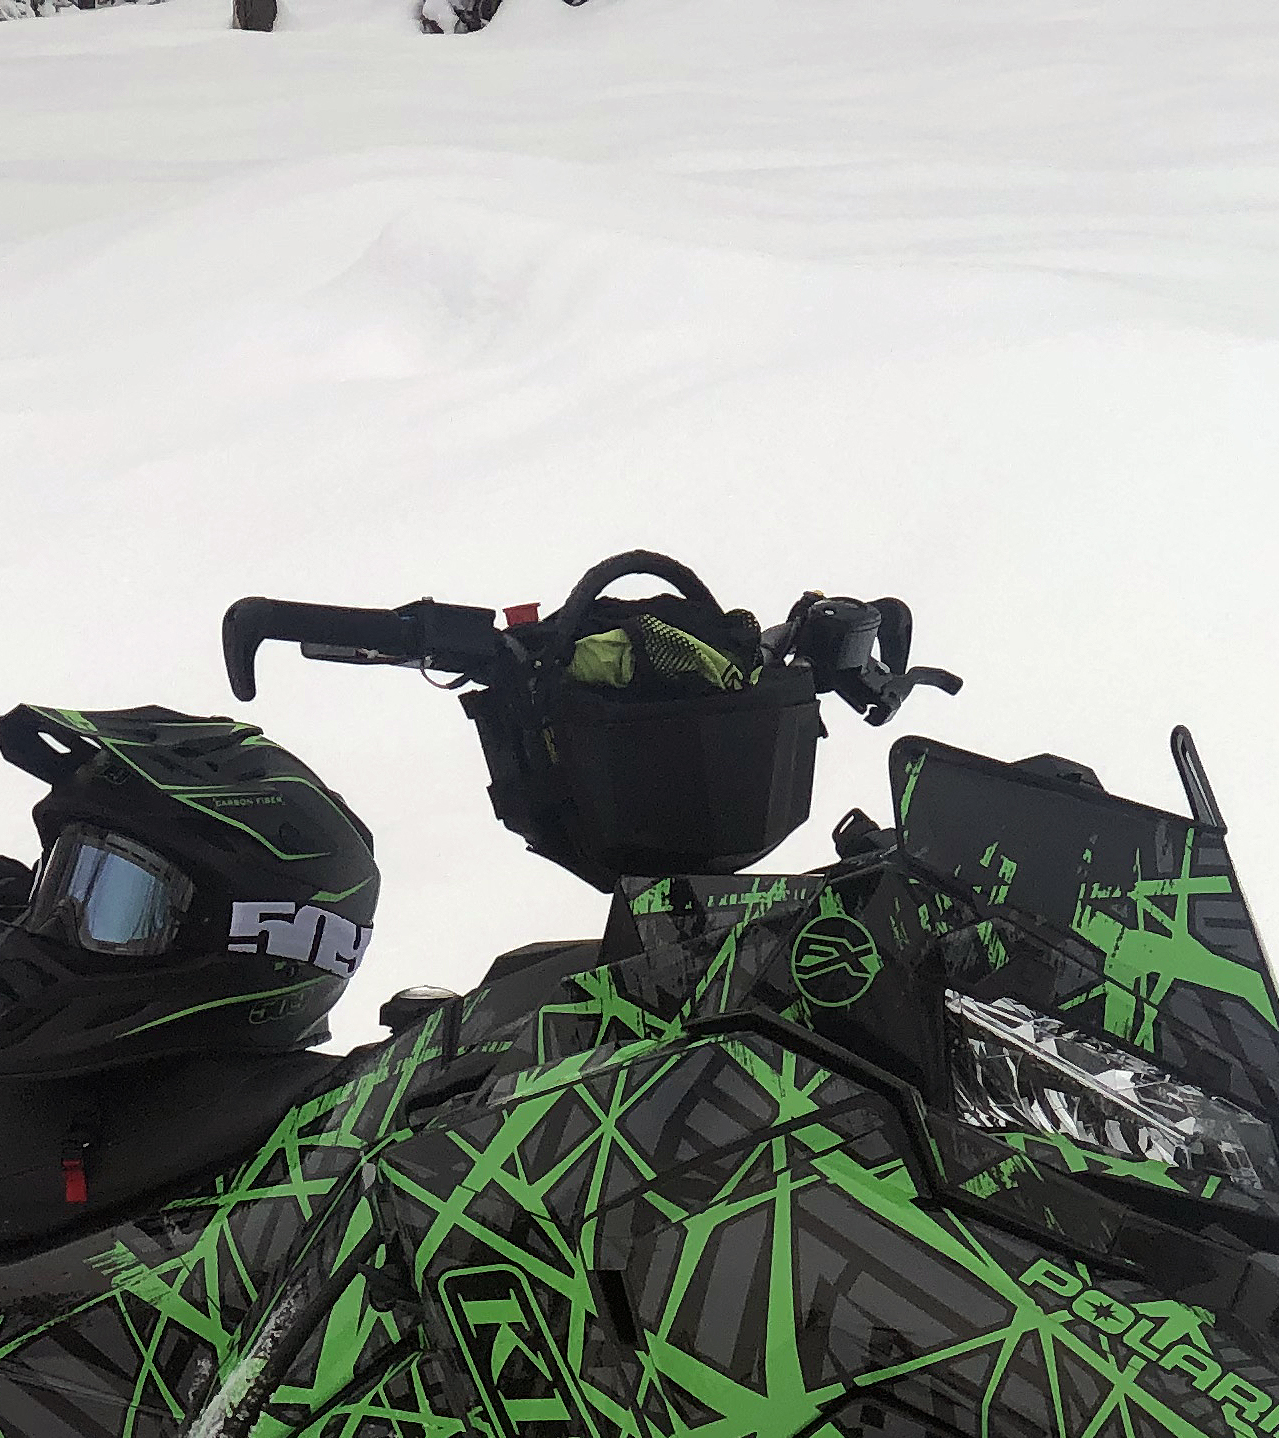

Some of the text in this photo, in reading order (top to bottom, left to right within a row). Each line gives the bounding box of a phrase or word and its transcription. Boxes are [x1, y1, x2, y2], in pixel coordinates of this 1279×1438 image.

[215, 796, 283, 807] CARBON FIBER
[227, 901, 374, 979] 509
